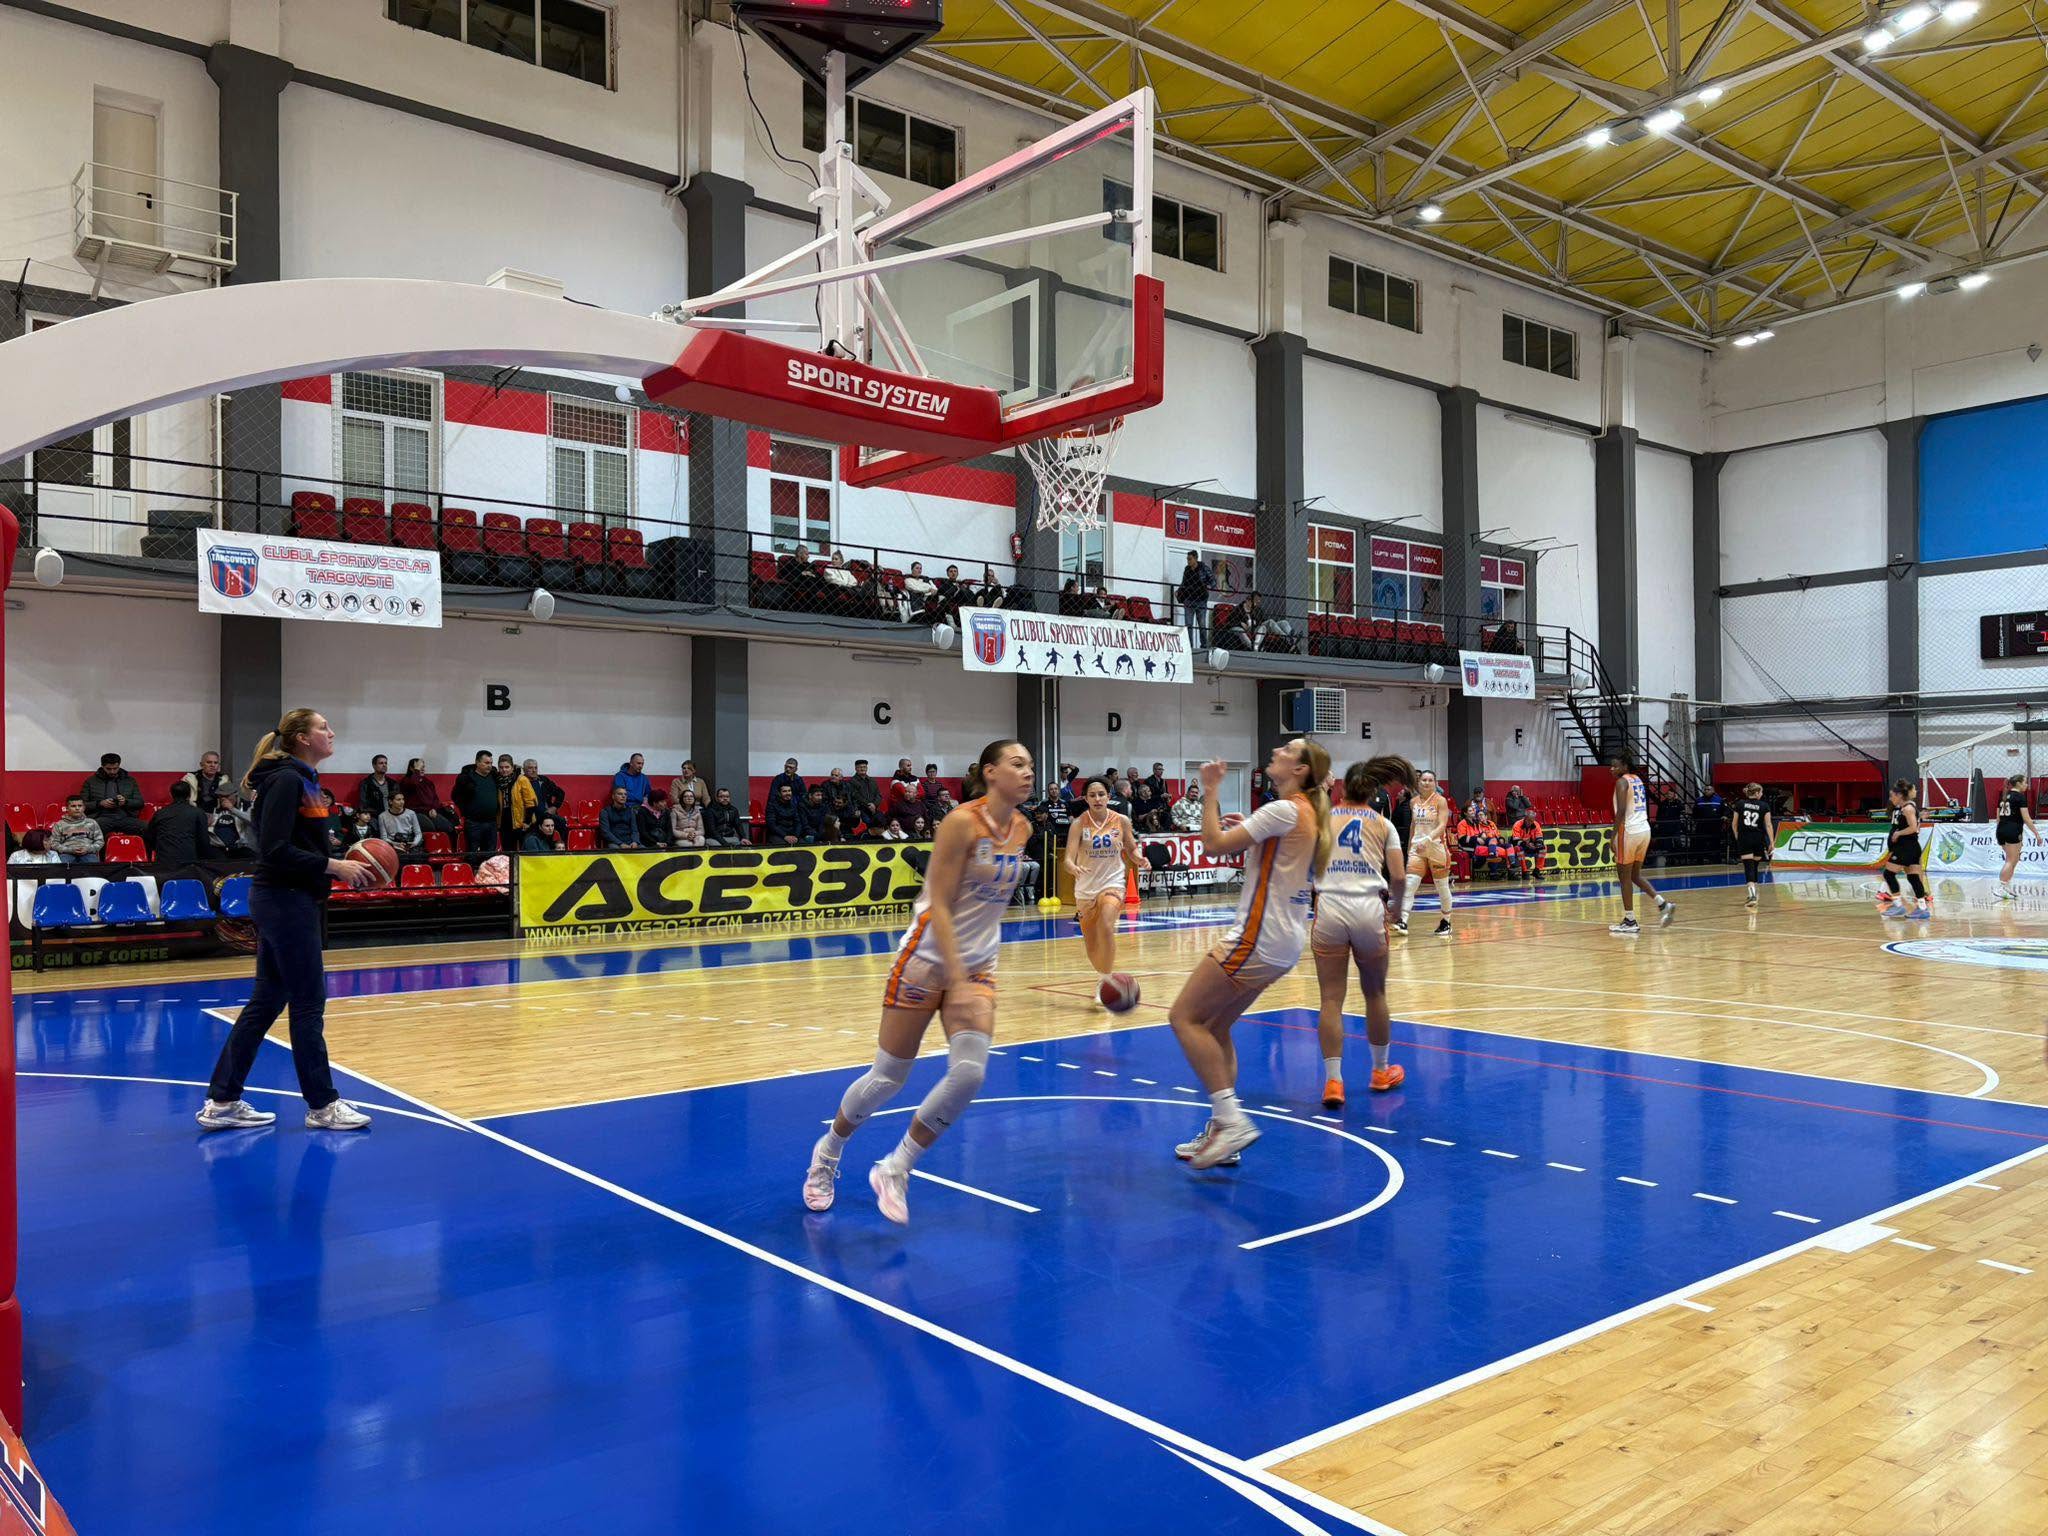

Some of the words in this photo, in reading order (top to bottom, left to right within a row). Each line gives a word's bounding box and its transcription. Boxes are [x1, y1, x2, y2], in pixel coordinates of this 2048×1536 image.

[787, 359, 863, 395] SPORT
[865, 379, 950, 415] SYSTEM
[1324, 540, 1347, 550] FOTBAL
[261, 544, 319, 563] CLUBUL
[320, 551, 379, 569] SPORTIV
[378, 556, 432, 574] SCOLAR
[306, 569, 394, 589] TARGOVISTE
[1504, 569, 1519, 577] JUDO
[1010, 618, 1049, 643] CLUBUL
[1049, 621, 1089, 647] SPORTIV
[2015, 622, 2036, 633] HOME
[486, 684, 511, 711] B
[873, 702, 892, 725] C
[1107, 712, 1122, 732] D
[1361, 722, 1372, 740] E
[1515, 728, 1523, 744] F
[1743, 810, 1760, 827] 32
[1092, 833, 1112, 850] 26
[1337, 818, 1363, 854] 4
[1787, 835, 1885, 854] CATENA
[993, 854, 1018, 883] 77
[13, 951, 73, 968] ORGIN
[81, 951, 103, 964] OF
[109, 948, 169, 963] COFFEE
